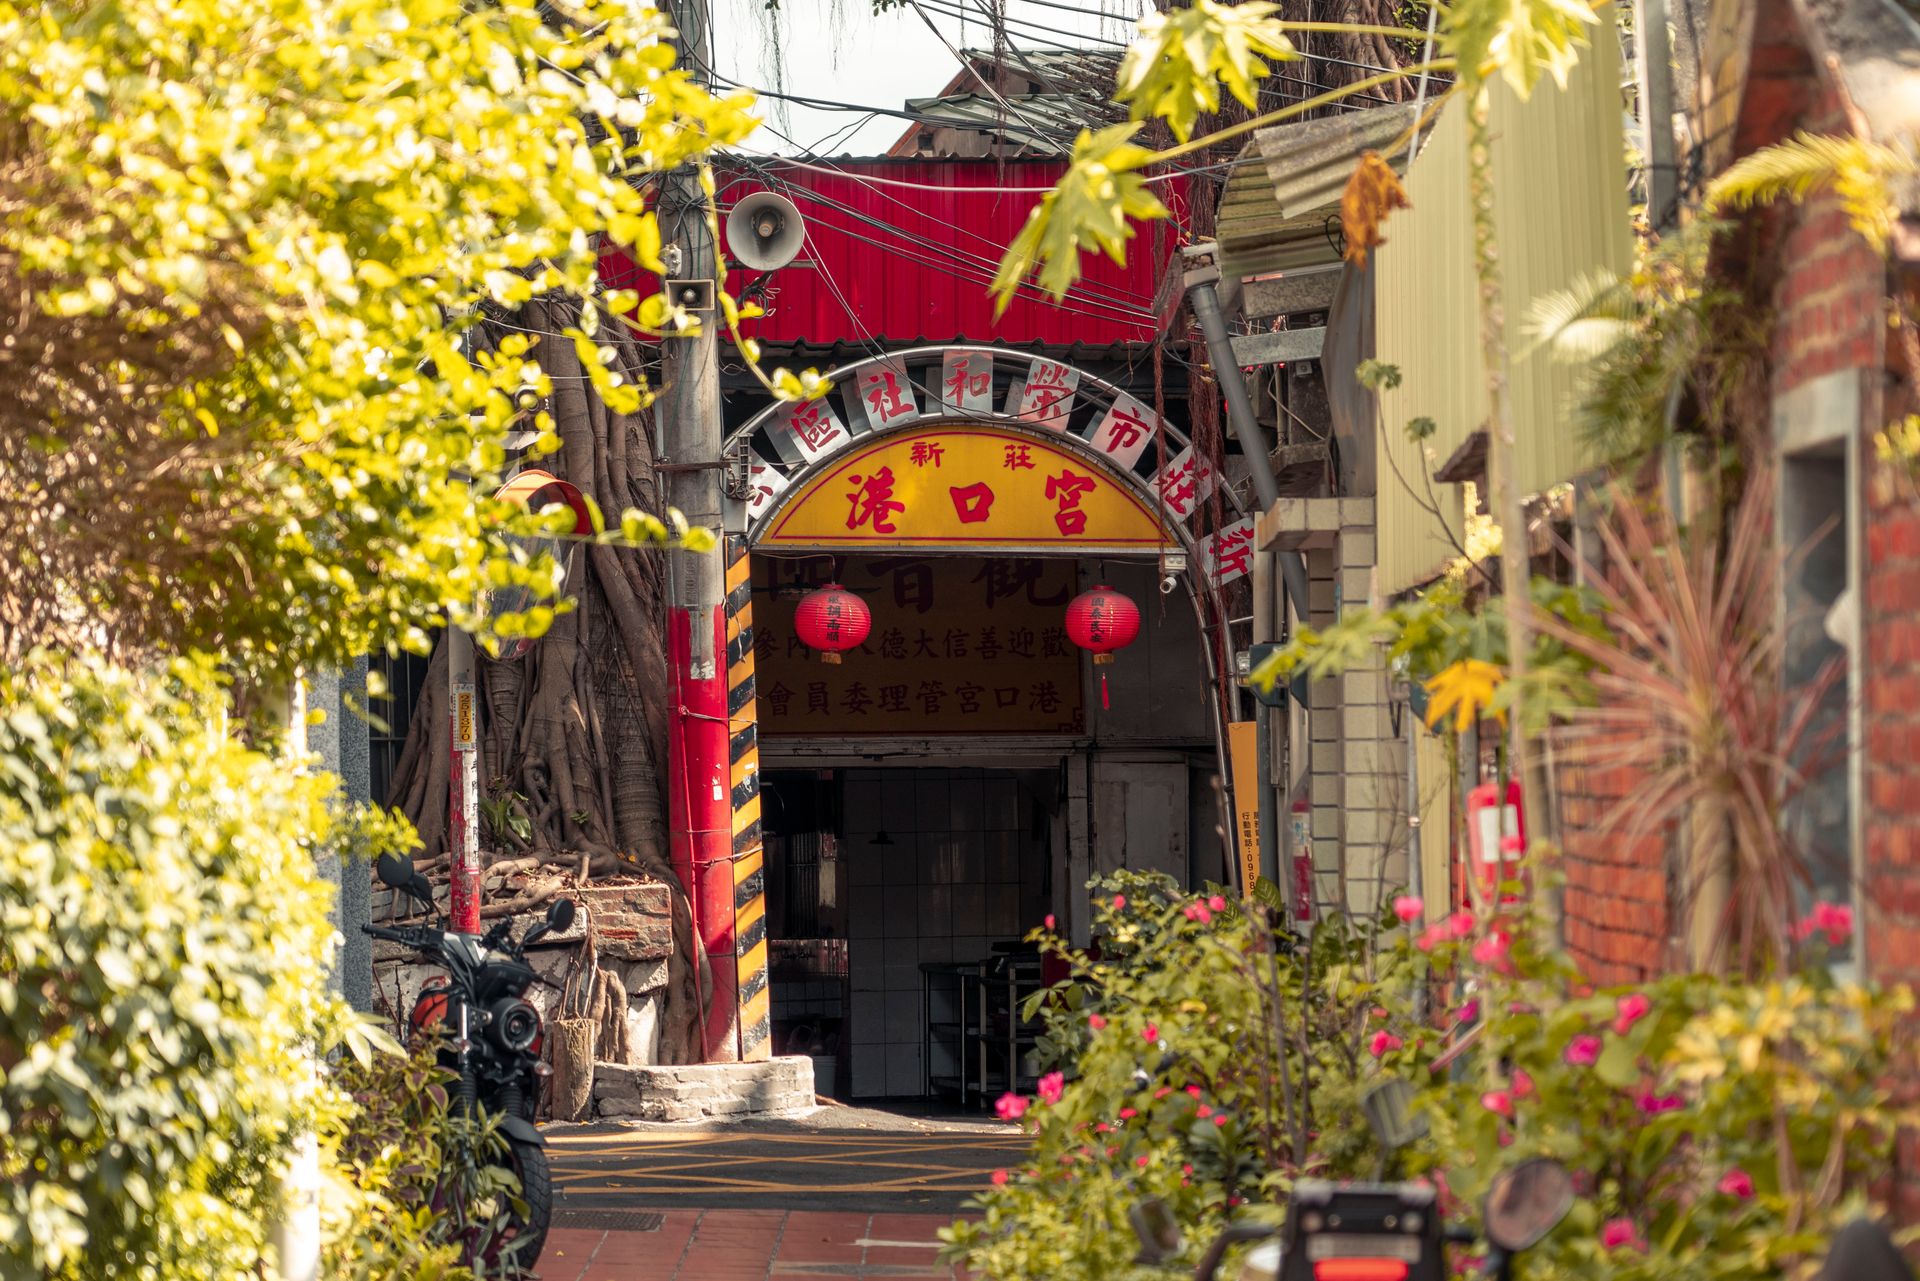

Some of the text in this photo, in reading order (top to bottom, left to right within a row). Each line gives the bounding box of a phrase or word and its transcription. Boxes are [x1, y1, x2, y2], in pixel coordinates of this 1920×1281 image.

[910, 442, 1036, 471] 新莊
[846, 466, 1097, 536] 港口宮
[461, 694, 470, 741] 251370
[766, 680, 1063, 716] 港口宮管理委員會
